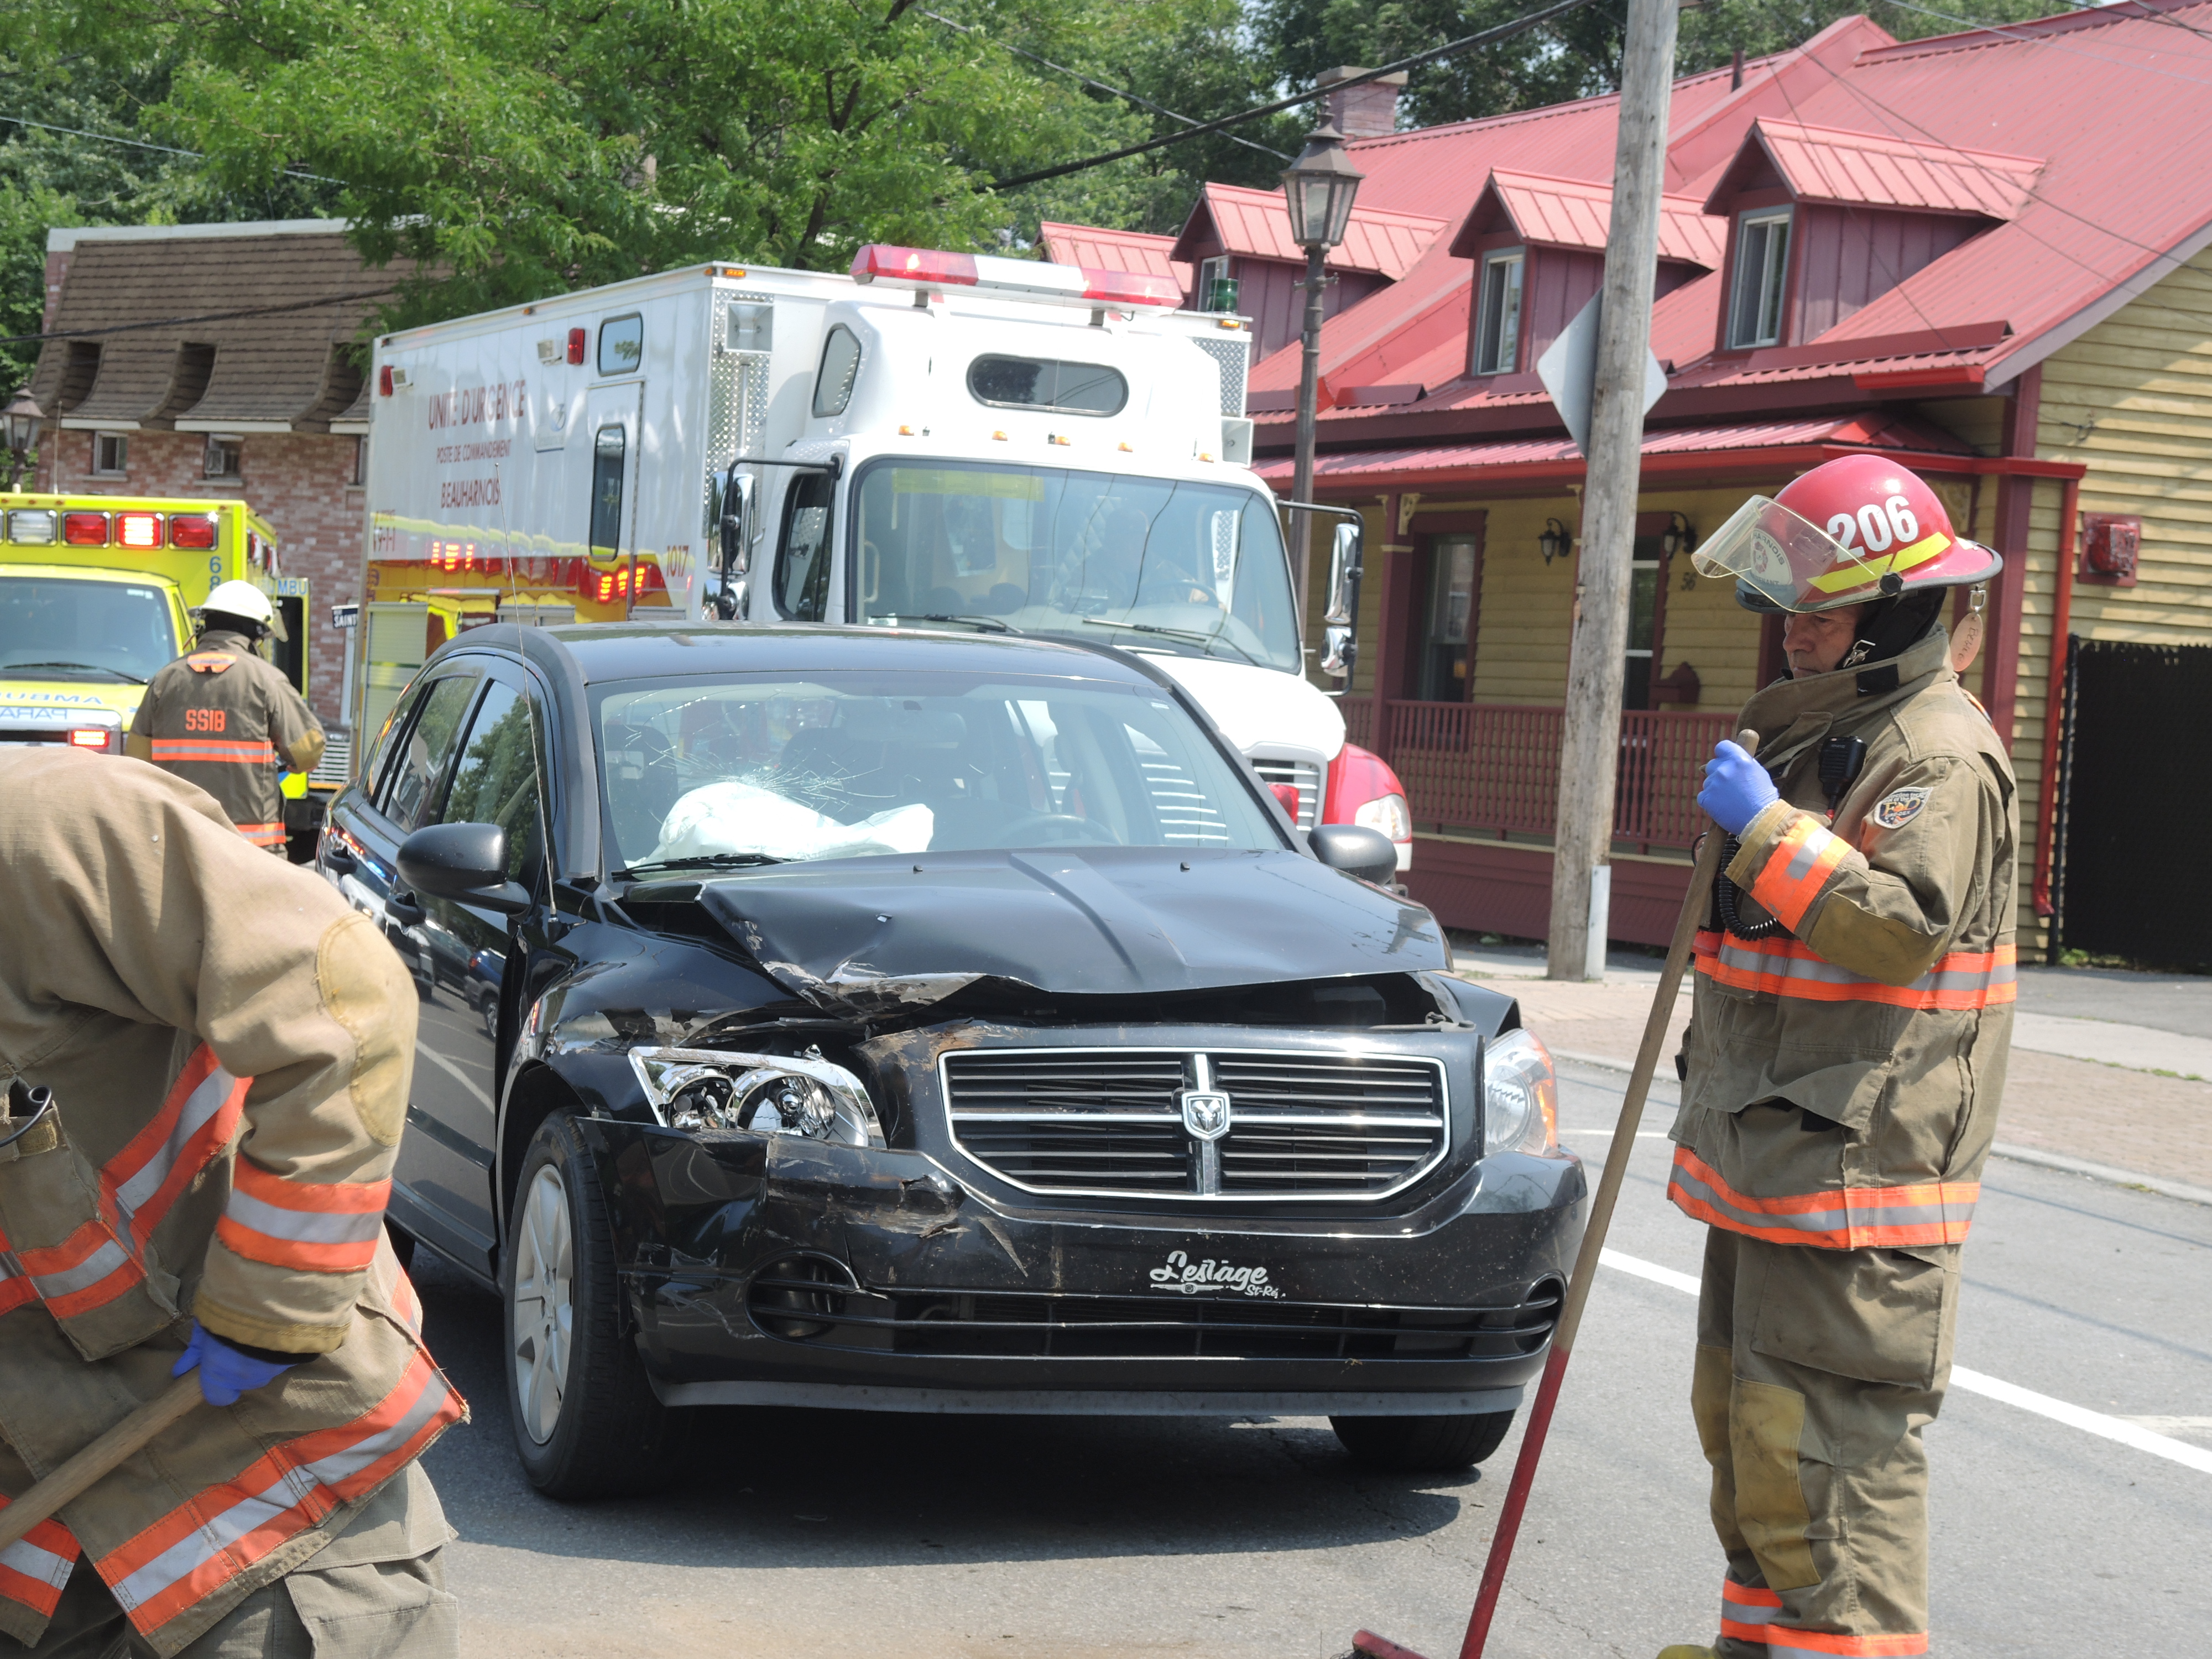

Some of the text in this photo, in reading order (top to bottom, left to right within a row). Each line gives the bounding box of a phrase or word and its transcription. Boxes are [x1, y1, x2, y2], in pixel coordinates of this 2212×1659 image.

[453, 445, 461, 462] DE
[441, 478, 499, 508] BEAUHARNOIS
[1827, 495, 1918, 564] 206
[667, 545, 689, 577] 1017
[1681, 572, 1697, 591] 56
[334, 614, 357, 628] SAINT
[185, 709, 226, 732] SSIB
